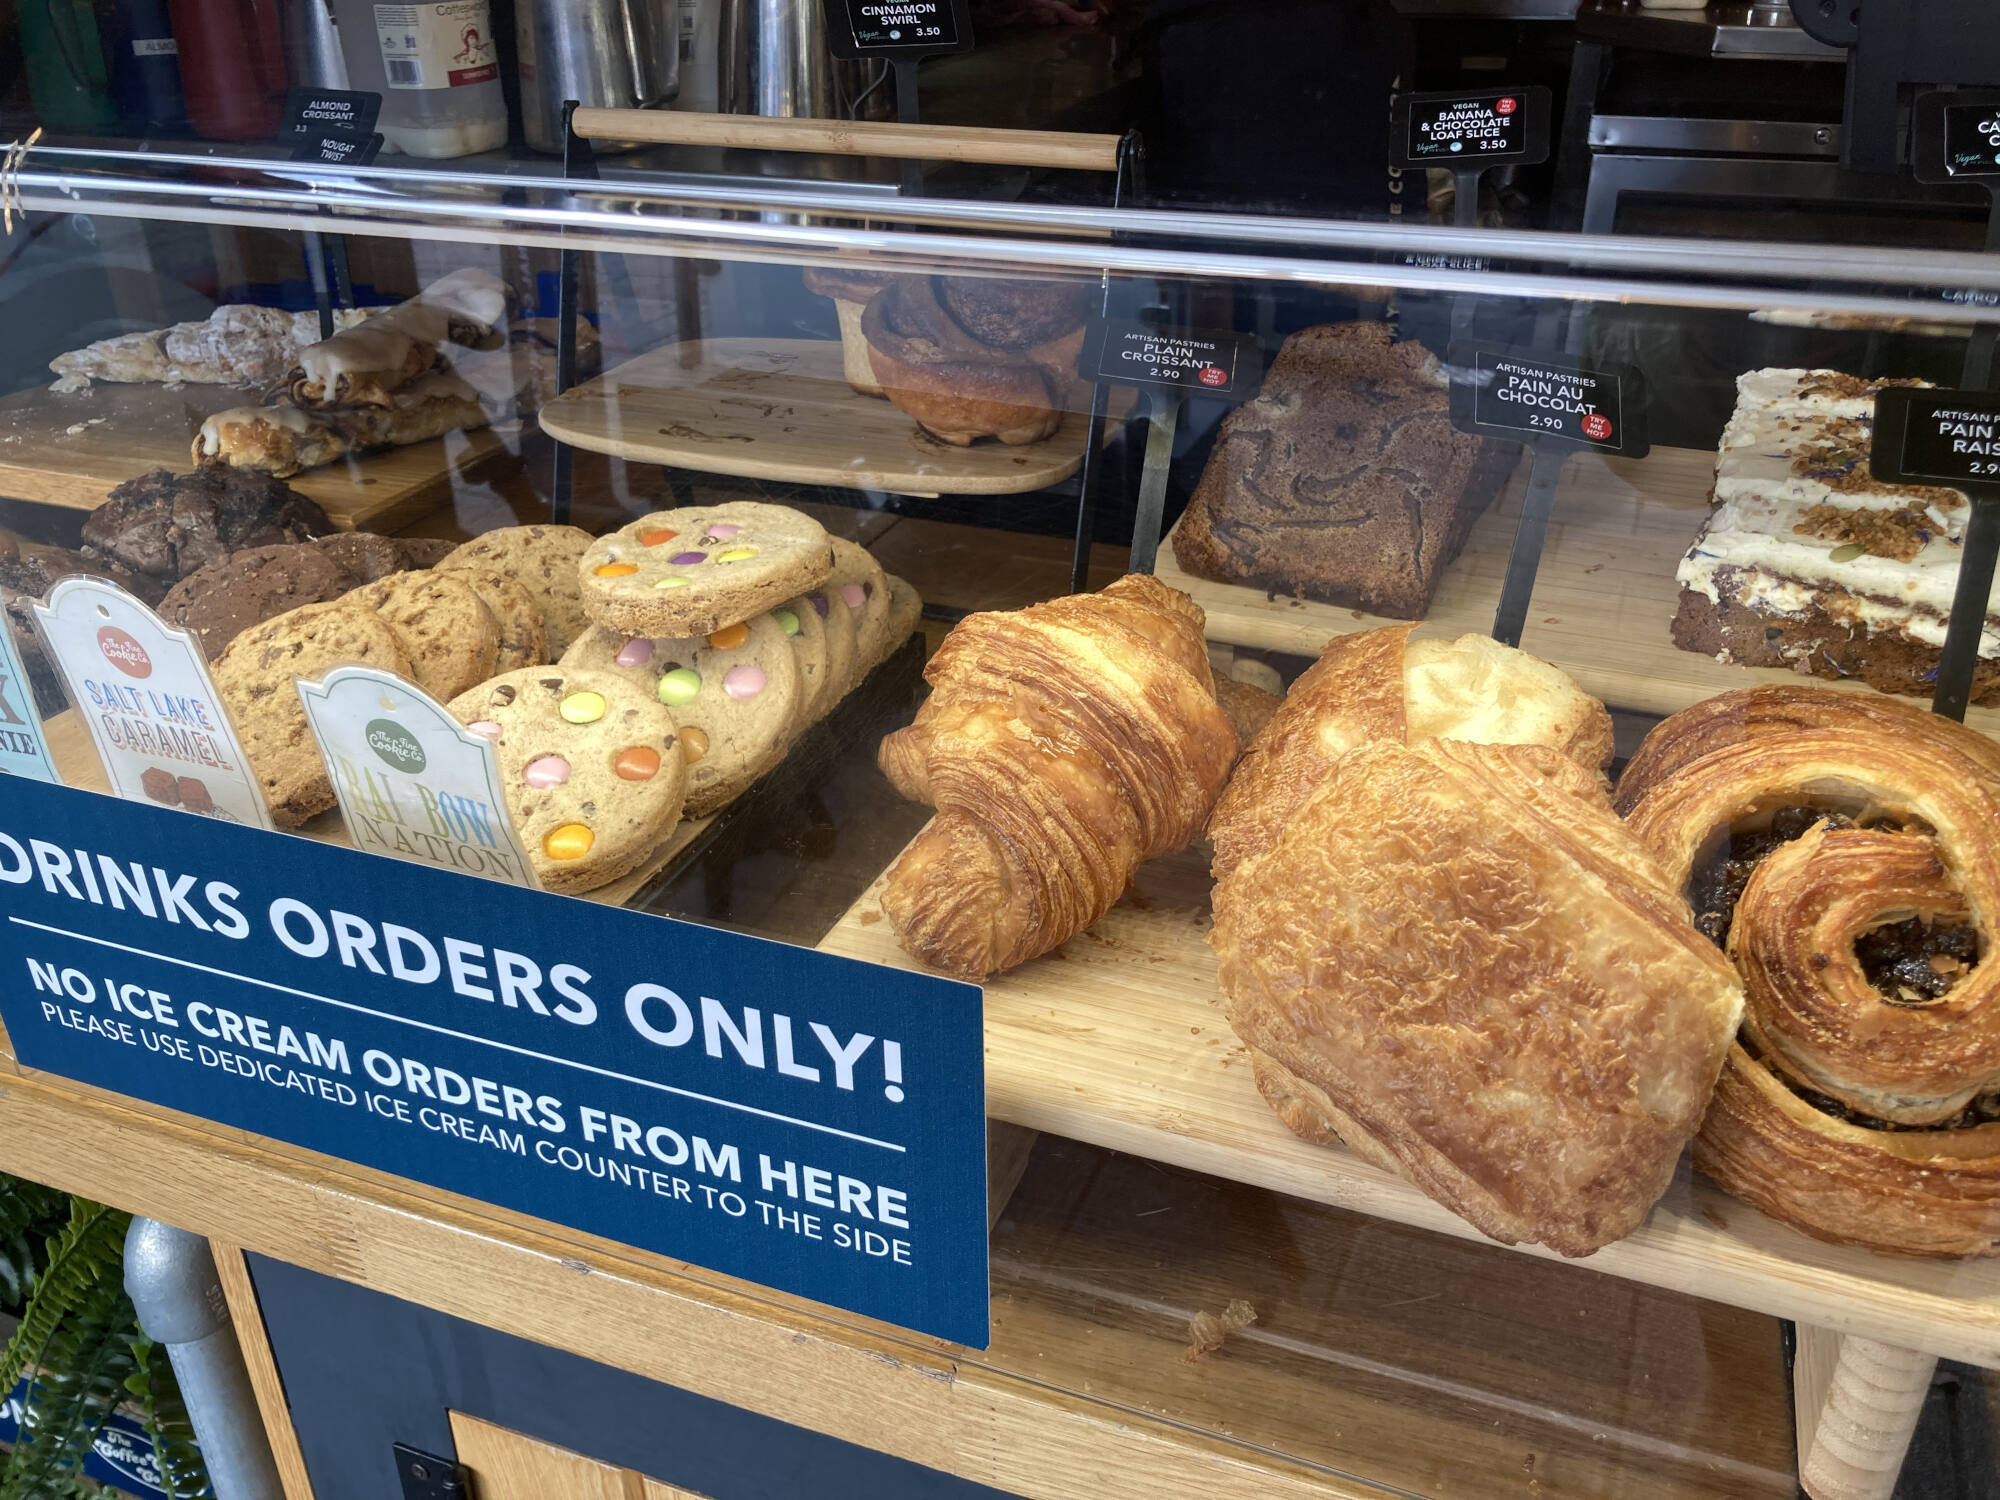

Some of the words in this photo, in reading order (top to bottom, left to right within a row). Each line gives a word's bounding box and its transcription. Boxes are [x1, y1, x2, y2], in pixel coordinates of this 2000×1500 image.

[861, 3, 936, 16] CINNAMON
[881, 15, 921, 25] SWIRL
[916, 27, 940, 36] 3.50
[309, 101, 351, 111] ALMOND
[302, 110, 354, 120] CROISSANT
[1439, 109, 1493, 121] BANANA
[1421, 123, 1430, 131] &
[1433, 117, 1511, 131] CHOCOLATE
[1430, 130, 1462, 141] LOAF
[1466, 128, 1500, 138] SLICE
[321, 139, 355, 153] NOUGAT
[1480, 140, 1507, 149] 3.50
[320, 149, 345, 161] TWIST
[1124, 333, 1167, 344] ARTISAN
[1170, 339, 1215, 350] PASTRIES
[1144, 343, 1193, 358] PLAIN
[1121, 351, 1214, 369] CROISSANT
[1150, 368, 1180, 379] 2.90
[1496, 363, 1543, 378] ARTISAN
[1546, 372, 1596, 388] PASTRIES
[1509, 376, 1552, 395] PAIN
[1557, 385, 1583, 400] AU
[1497, 388, 1596, 415] CHOCOLAT
[1530, 415, 1563, 429] 2.90
[1590, 416, 1605, 424] TRY
[1931, 410, 1990, 423] ARTISAN
[1586, 429, 1604, 438] HOT
[1939, 422, 1993, 439] PAIN
[1969, 462, 2000, 475] 2.9
[102, 642, 138, 666] Cookie
[85, 679, 147, 716] SALT
[148, 690, 214, 731] LAKE
[102, 714, 233, 771] CARAMEL
[369, 733, 410, 762] Cookie
[376, 731, 392, 743] The
[399, 738, 417, 751] Fine
[337, 754, 497, 849] RAIBOW
[355, 812, 514, 881] NATION
[0, 832, 250, 940] DRINKS
[268, 897, 598, 1026] ORDERS
[624, 982, 905, 1103] ONLY!
[26, 957, 96, 1004] NO
[104, 978, 179, 1028] ICE
[186, 1001, 352, 1075] CREAM
[362, 1049, 566, 1133] ORDERS
[579, 1105, 742, 1183] FROM
[759, 1153, 910, 1230] HERE
[40, 1001, 137, 1046] PLEASE
[139, 1028, 194, 1062] USE
[197, 1044, 357, 1106] DEDICATED
[364, 1090, 413, 1124] ICE
[419, 1107, 527, 1156] CREAM
[535, 1140, 693, 1203] COUNTER
[698, 1184, 747, 1217] TO
[754, 1199, 823, 1241] THE
[833, 1222, 913, 1266] SIDE
[94, 1439, 148, 1466] Coffee
